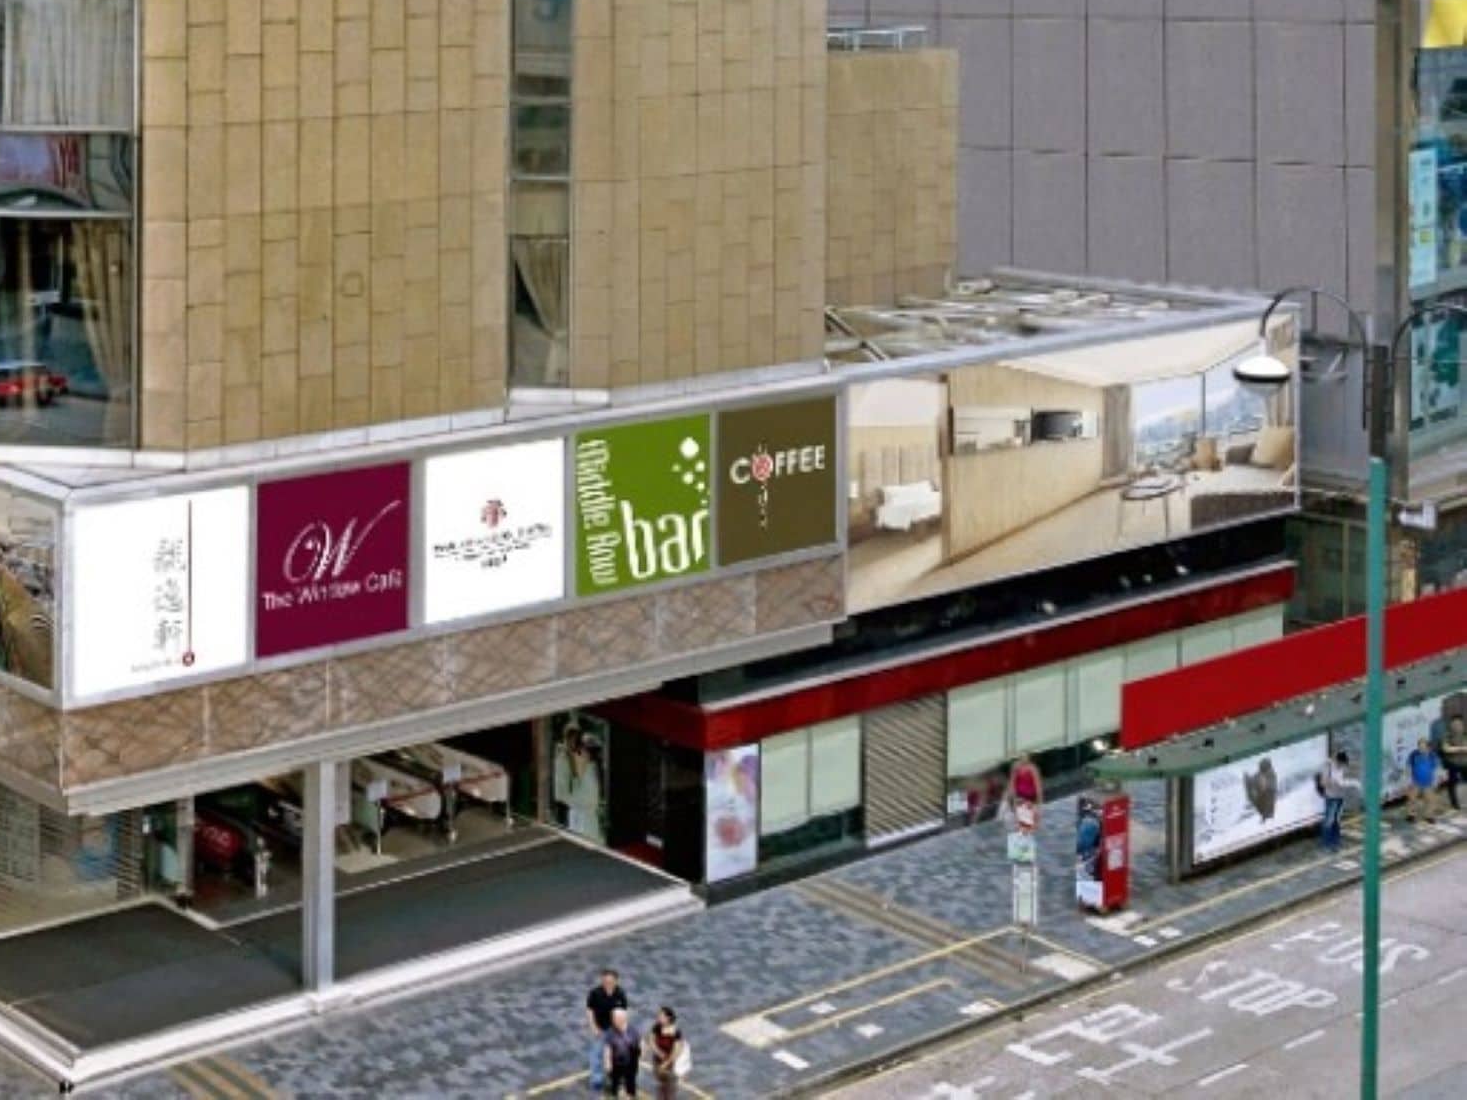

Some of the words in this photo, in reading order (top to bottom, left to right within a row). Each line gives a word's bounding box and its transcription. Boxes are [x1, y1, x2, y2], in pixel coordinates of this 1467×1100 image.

[729, 444, 826, 484] COFFEE
[620, 500, 709, 580] bar
[262, 591, 295, 611] The
[1164, 960, 1338, 1016] STOP
